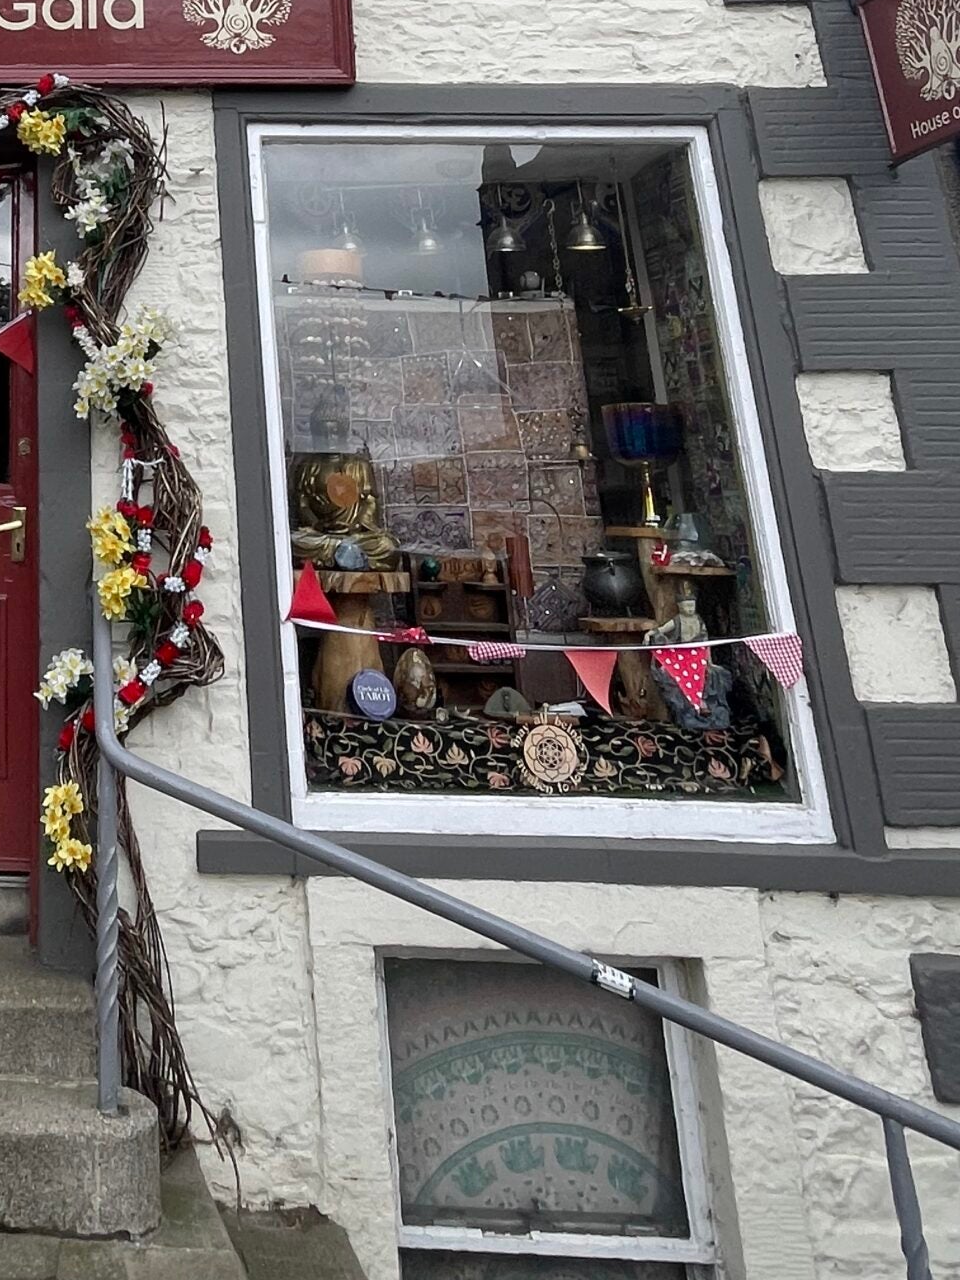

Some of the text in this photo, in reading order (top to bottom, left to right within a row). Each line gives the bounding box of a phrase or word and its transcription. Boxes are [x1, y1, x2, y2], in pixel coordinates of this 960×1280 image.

[910, 111, 951, 139] House
[360, 690, 391, 702] TAROT
[510, 722, 530, 749] may
[533, 711, 548, 725] all
[557, 781, 570, 795] to
